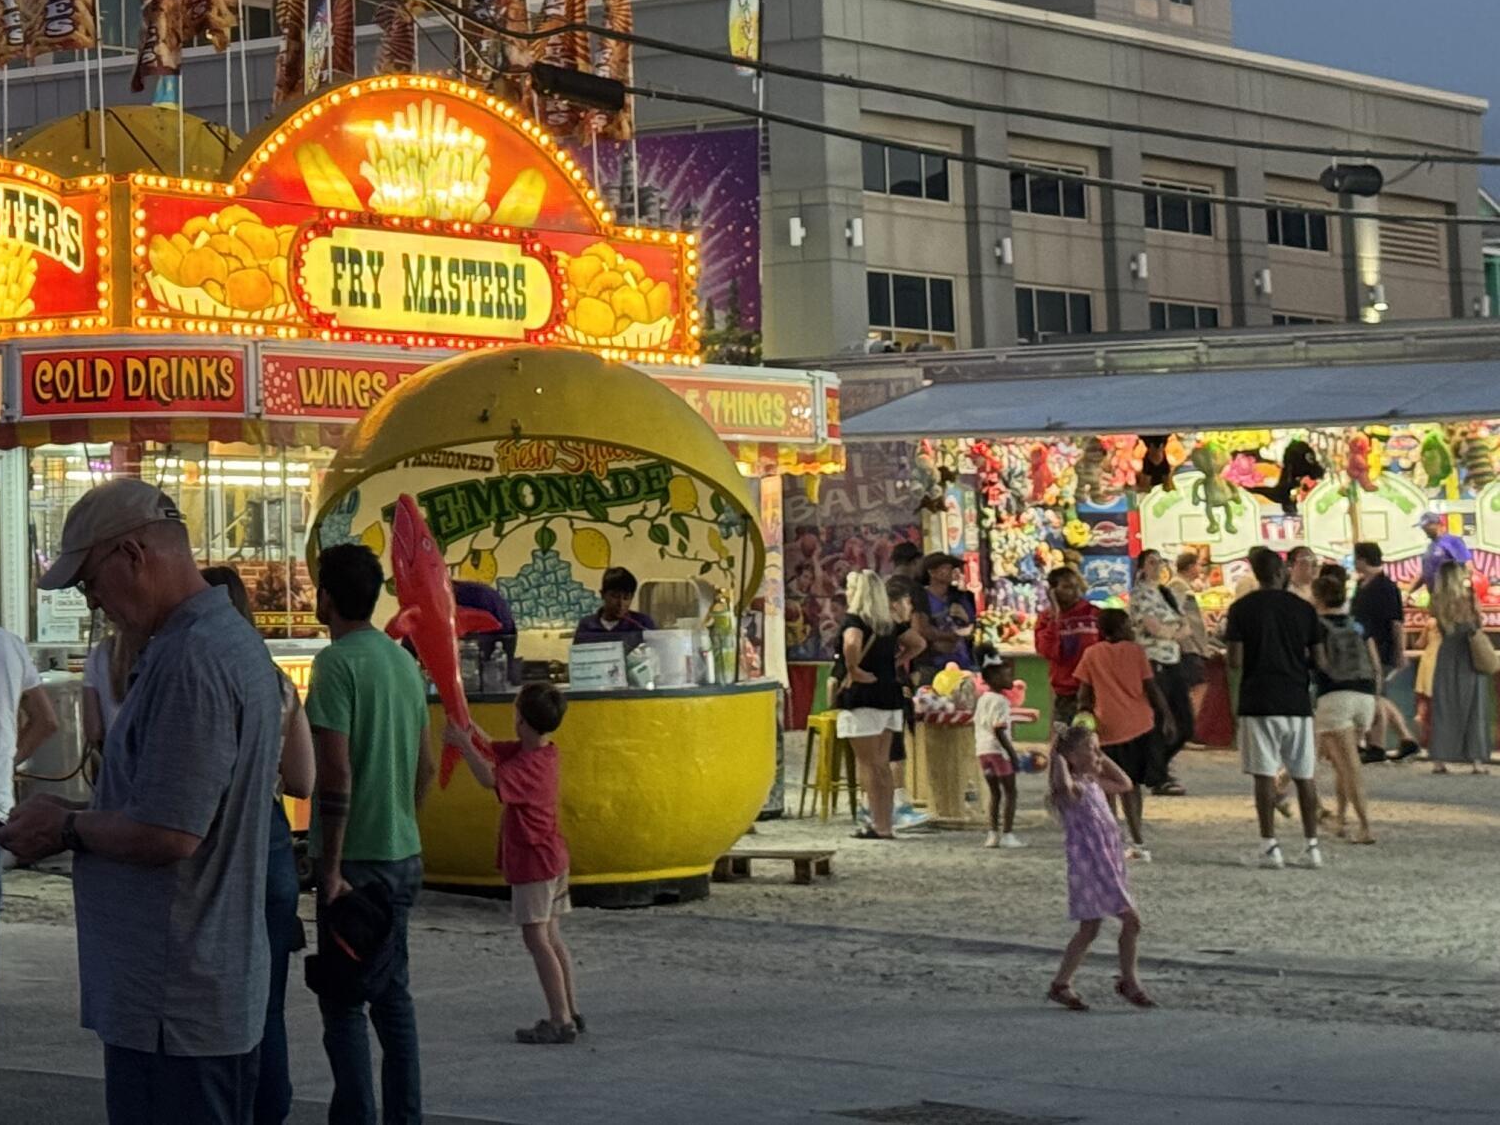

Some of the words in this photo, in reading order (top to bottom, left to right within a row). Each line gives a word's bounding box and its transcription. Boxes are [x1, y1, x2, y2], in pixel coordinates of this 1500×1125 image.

[330, 245, 383, 309] FRY
[402, 253, 527, 321] MASTERS
[34, 360, 114, 403] COLD
[122, 357, 236, 402] DRINKS
[298, 367, 388, 408] WINGS
[706, 389, 788, 427] THINGS
[494, 439, 556, 474] Fresh
[382, 460, 673, 550] EMONADE
